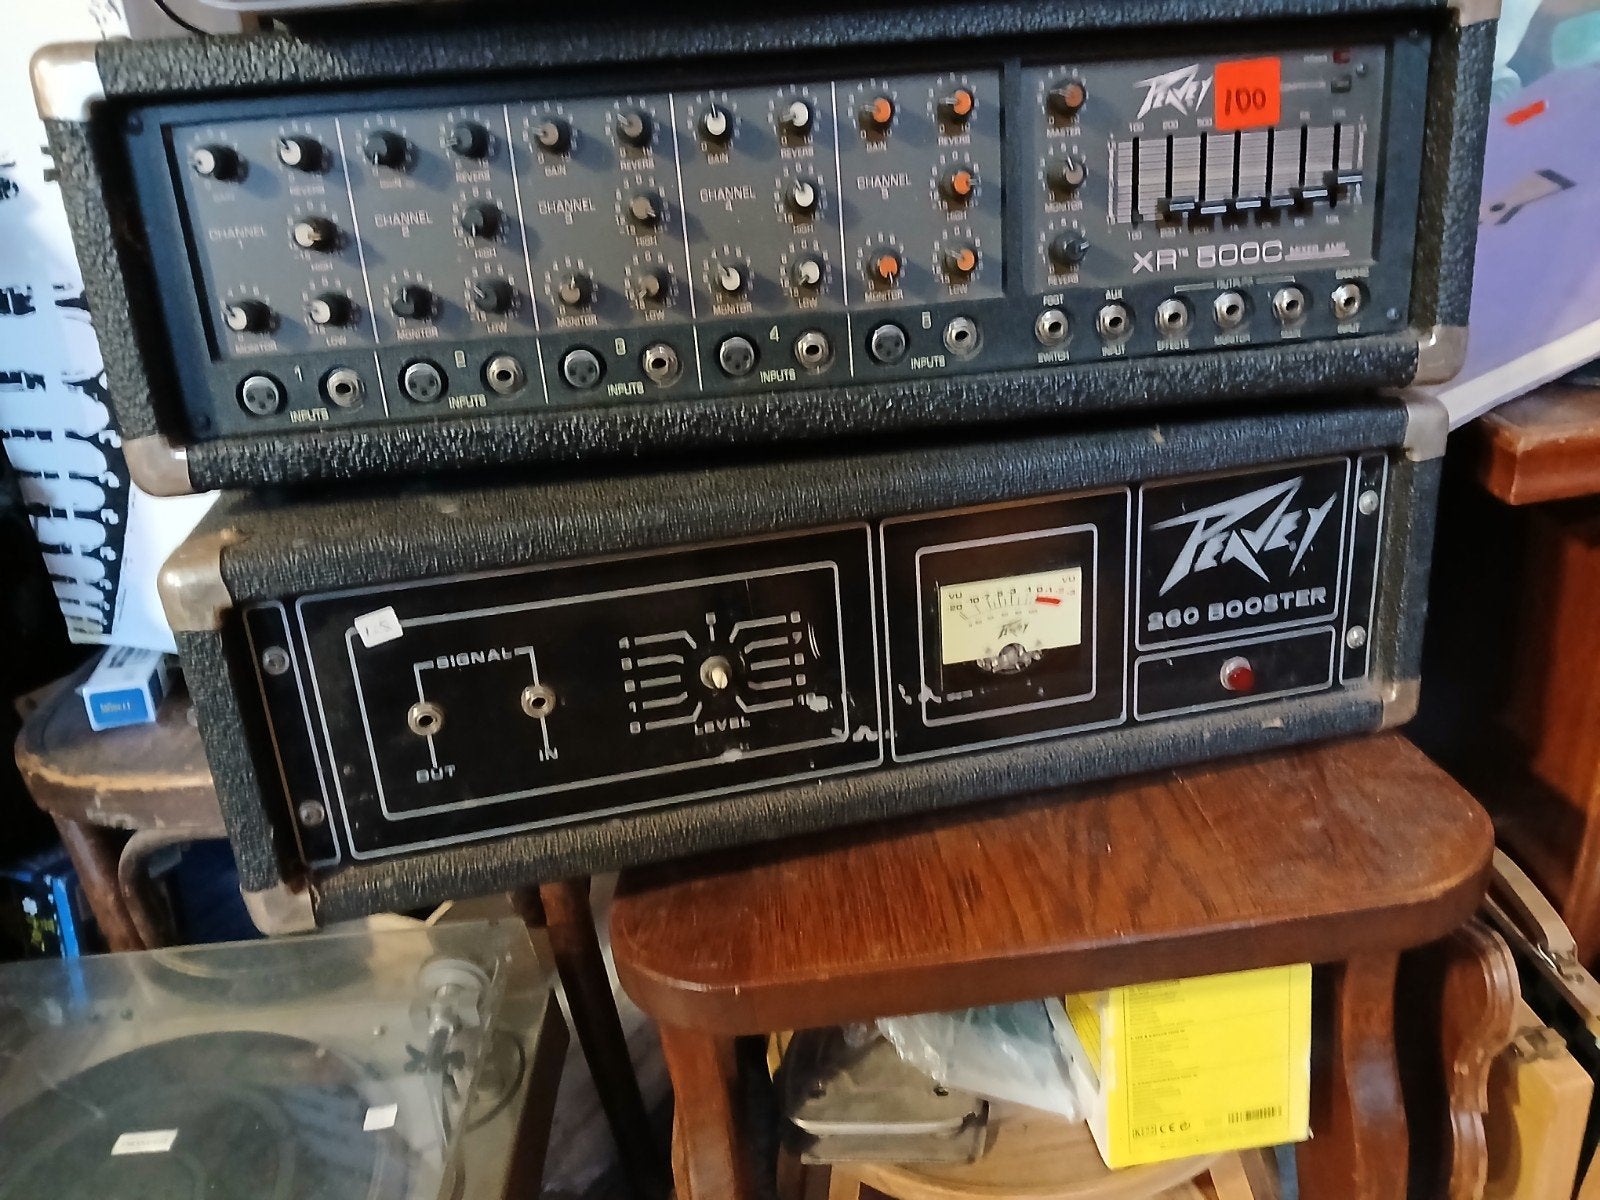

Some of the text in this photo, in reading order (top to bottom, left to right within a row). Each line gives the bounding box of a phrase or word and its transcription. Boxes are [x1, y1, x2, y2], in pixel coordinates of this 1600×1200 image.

[1224, 87, 1267, 116] 100
[938, 134, 970, 146] REVERB
[1047, 128, 1081, 138] MASTER
[780, 147, 814, 159] REVERB
[857, 173, 912, 190] CHANNEL
[699, 185, 756, 203] CHANNEL
[538, 197, 596, 215] CHANNEL
[1045, 202, 1083, 213] MONITOR
[374, 210, 433, 228] CHANNEL
[208, 225, 266, 240] CHANNEL
[864, 289, 904, 303] MONITOR
[948, 283, 968, 295] LOW
[713, 301, 753, 316] MONITOR
[798, 297, 818, 309] LOW
[556, 314, 598, 328] MONITOR
[645, 310, 665, 321] LOW
[487, 322, 507, 333] LOW
[769, 325, 780, 342] 4
[1037, 350, 1070, 363] SWITCH
[1102, 344, 1125, 357] INPUT
[910, 355, 946, 370] INPUTS
[294, 364, 303, 382] 1
[760, 368, 797, 383] INPUTS
[607, 381, 644, 396] INPUTS
[448, 394, 487, 410] INPUTS
[290, 408, 329, 423] INPUTS
[1149, 475, 1337, 597] PEAVEY
[948, 592, 963, 600] VU
[1208, 586, 1327, 622] BOOSTER
[436, 647, 512, 669] SIGNAL
[694, 716, 750, 736] LEVEL
[539, 747, 558, 762] IN
[416, 764, 456, 784] OUT
